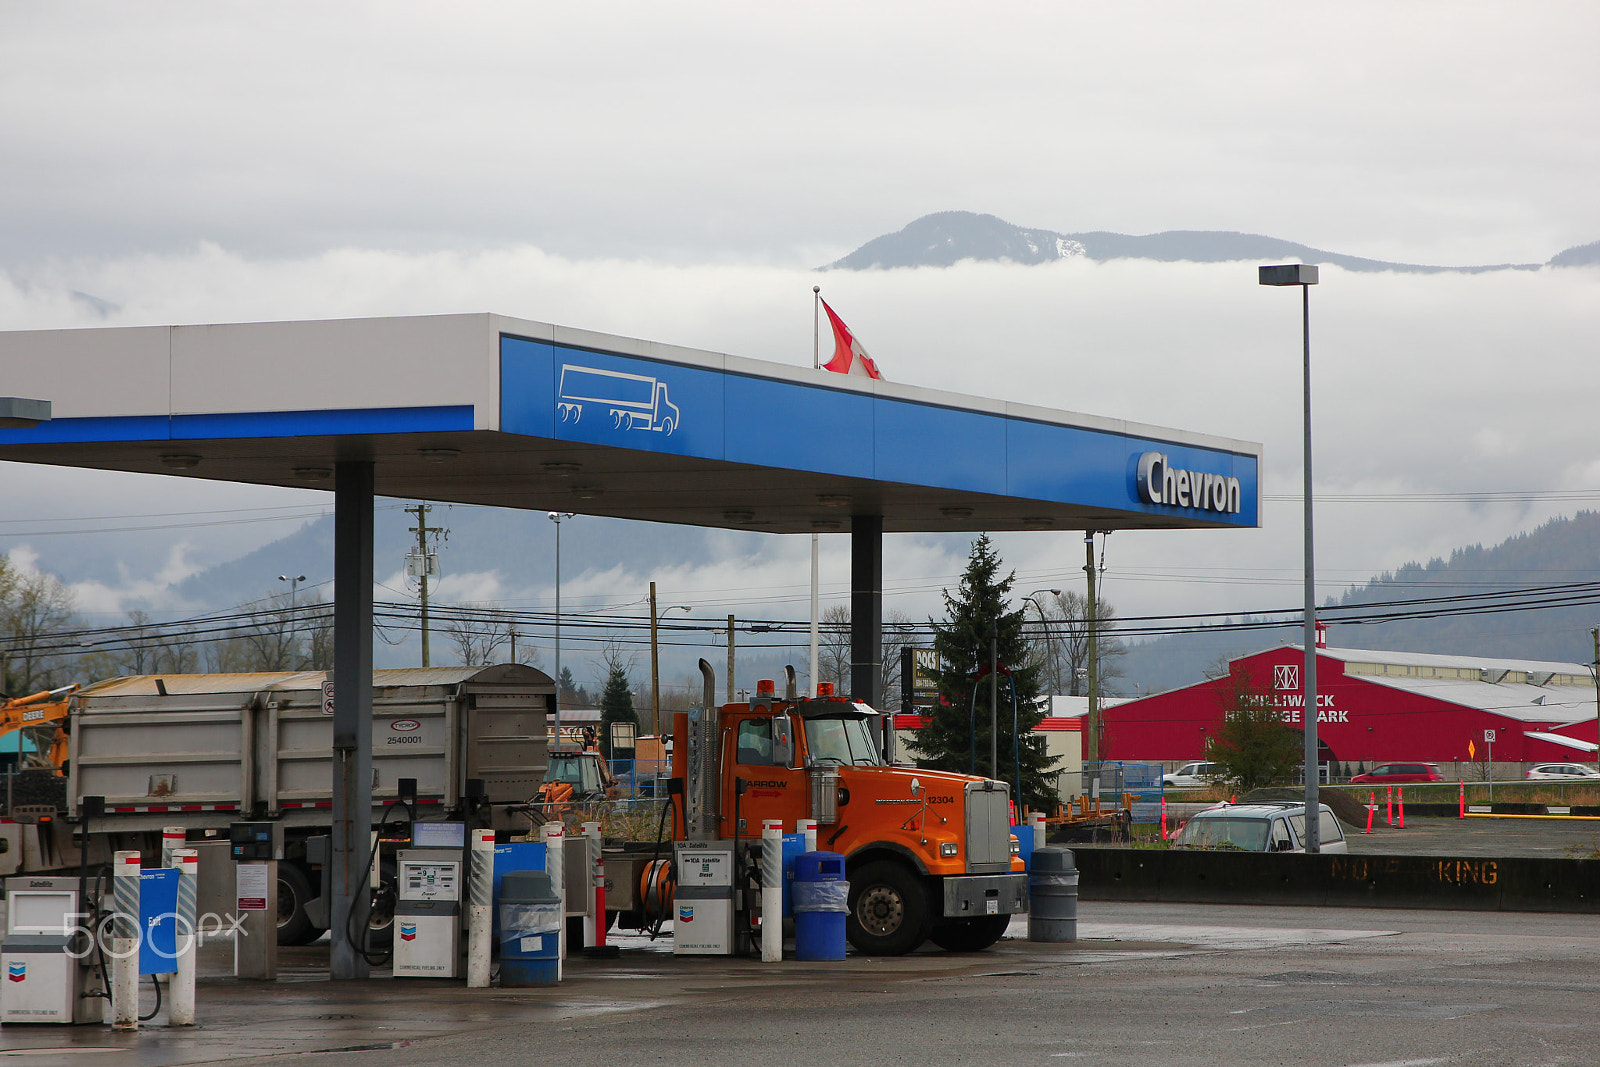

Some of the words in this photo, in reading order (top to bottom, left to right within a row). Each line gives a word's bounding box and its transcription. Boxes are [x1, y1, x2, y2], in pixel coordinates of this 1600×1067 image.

[1138, 451, 1241, 514] Chevron
[1239, 694, 1335, 707] CHILLIWCK
[23, 709, 45, 721] DEERE
[1316, 711, 1350, 722] ARK
[387, 736, 423, 744] 2540001
[746, 780, 788, 788] ARROW
[927, 796, 954, 804] 12304
[1331, 857, 1367, 880] NO
